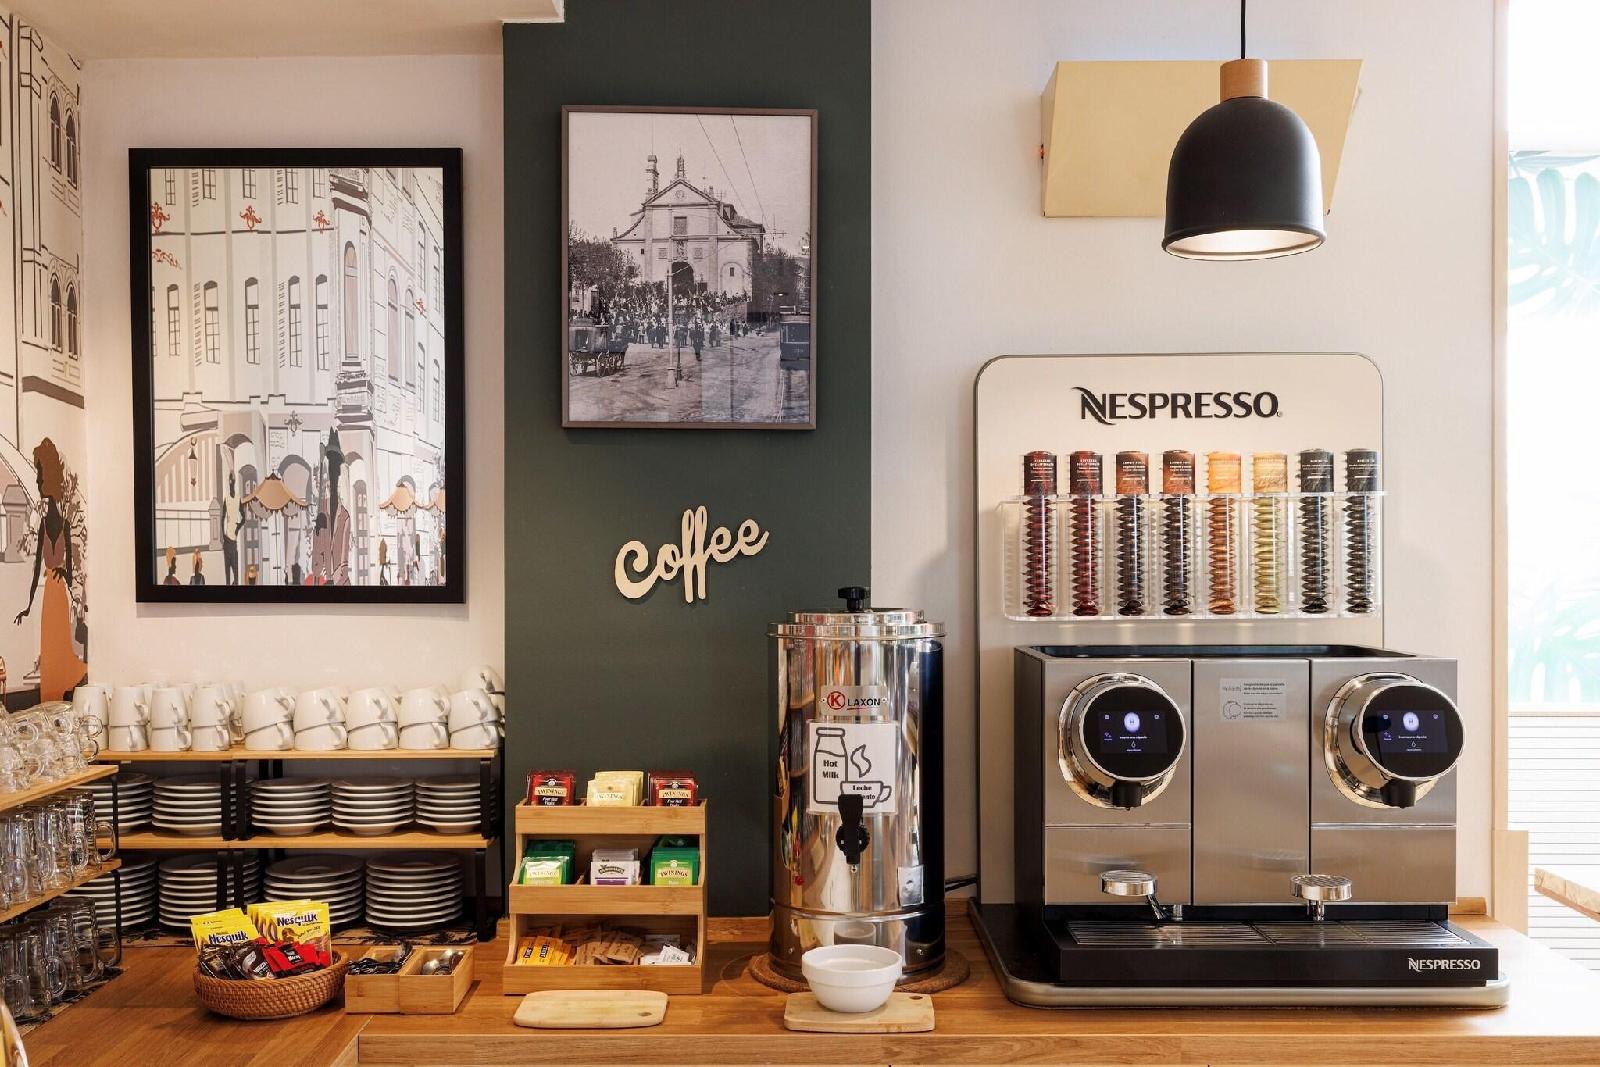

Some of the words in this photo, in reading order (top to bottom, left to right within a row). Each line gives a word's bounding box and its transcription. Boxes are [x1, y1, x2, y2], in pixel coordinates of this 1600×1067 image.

[1071, 386, 1279, 426] NESPRESSO
[823, 759, 838, 768] Hot
[822, 771, 839, 779] Milk
[852, 784, 873, 792] Leche
[277, 913, 318, 927] Nesquik
[208, 931, 249, 945] Nesquik
[1407, 957, 1481, 973] NESPRESSO
